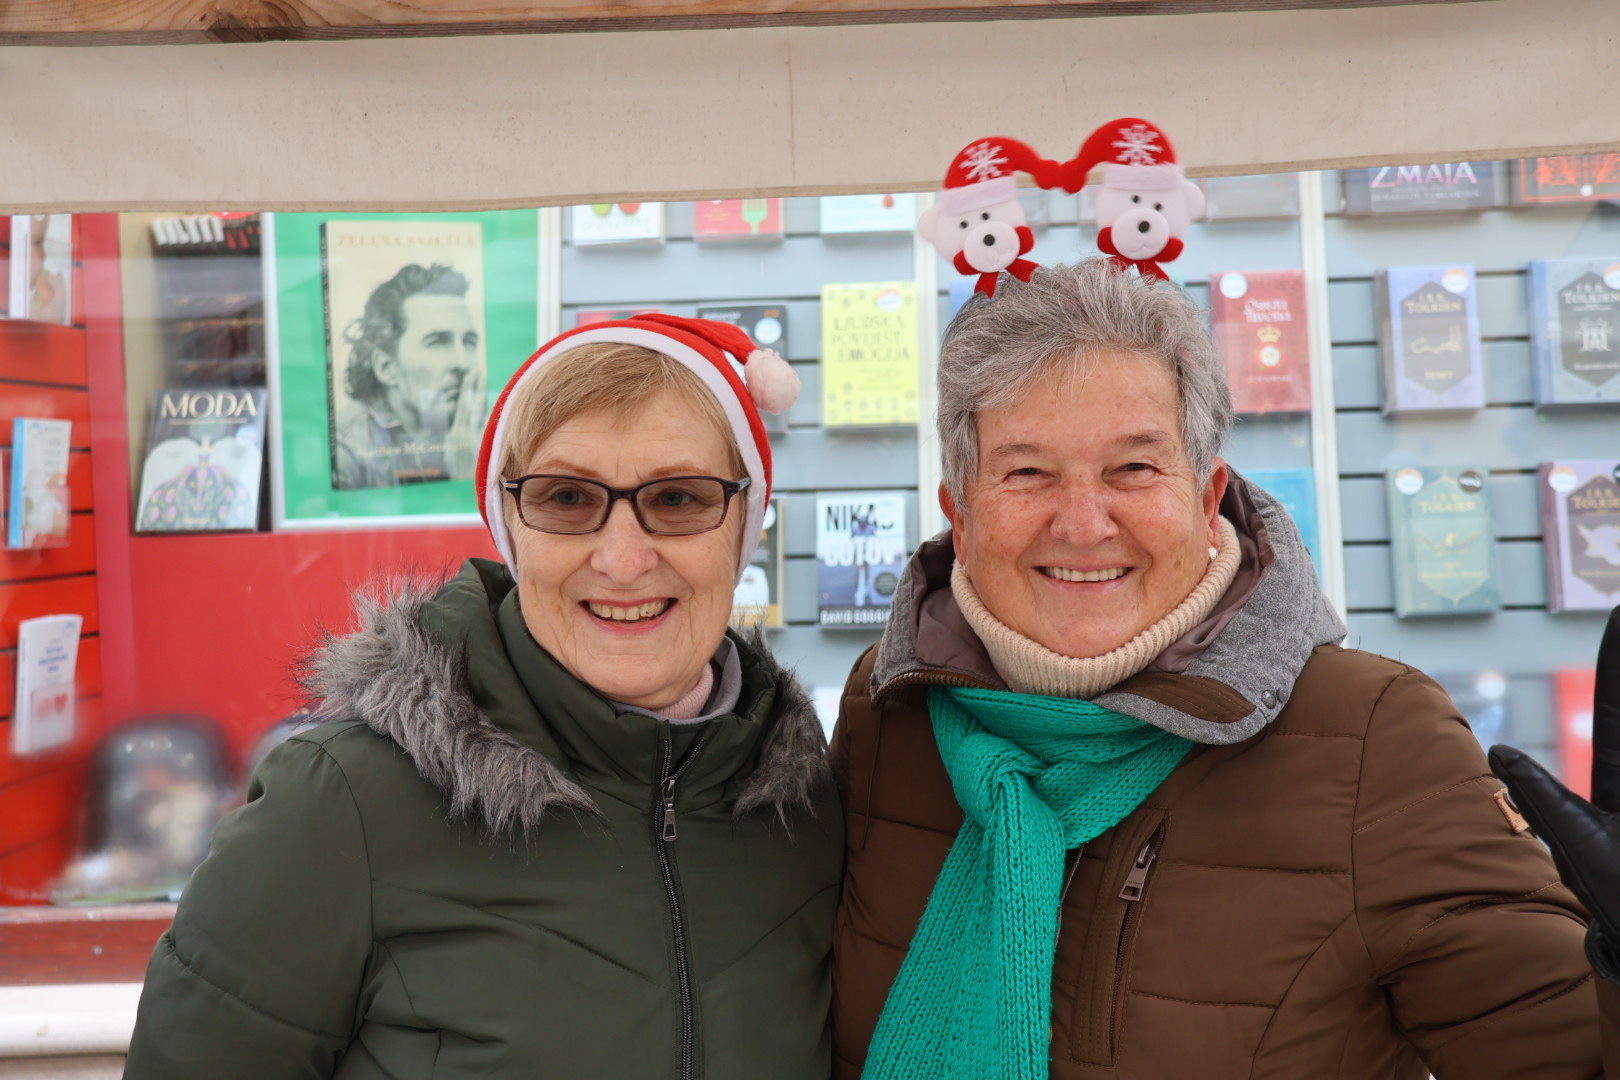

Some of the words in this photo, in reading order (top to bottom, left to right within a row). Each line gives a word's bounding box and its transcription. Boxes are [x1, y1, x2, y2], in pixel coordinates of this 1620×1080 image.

[338, 234, 402, 249] ZELENA
[1405, 300, 1462, 314] TOLKIEN
[833, 316, 905, 331] LJUDSKA
[830, 332, 901, 346] POVIJEST
[838, 347, 911, 362] EMOCIJA
[162, 391, 257, 418] MODA
[1420, 500, 1476, 513] TOLKIEN
[1571, 495, 1620, 509] TOLKIE
[823, 537, 896, 567] GOTOV
[821, 609, 853, 624] DAVID
